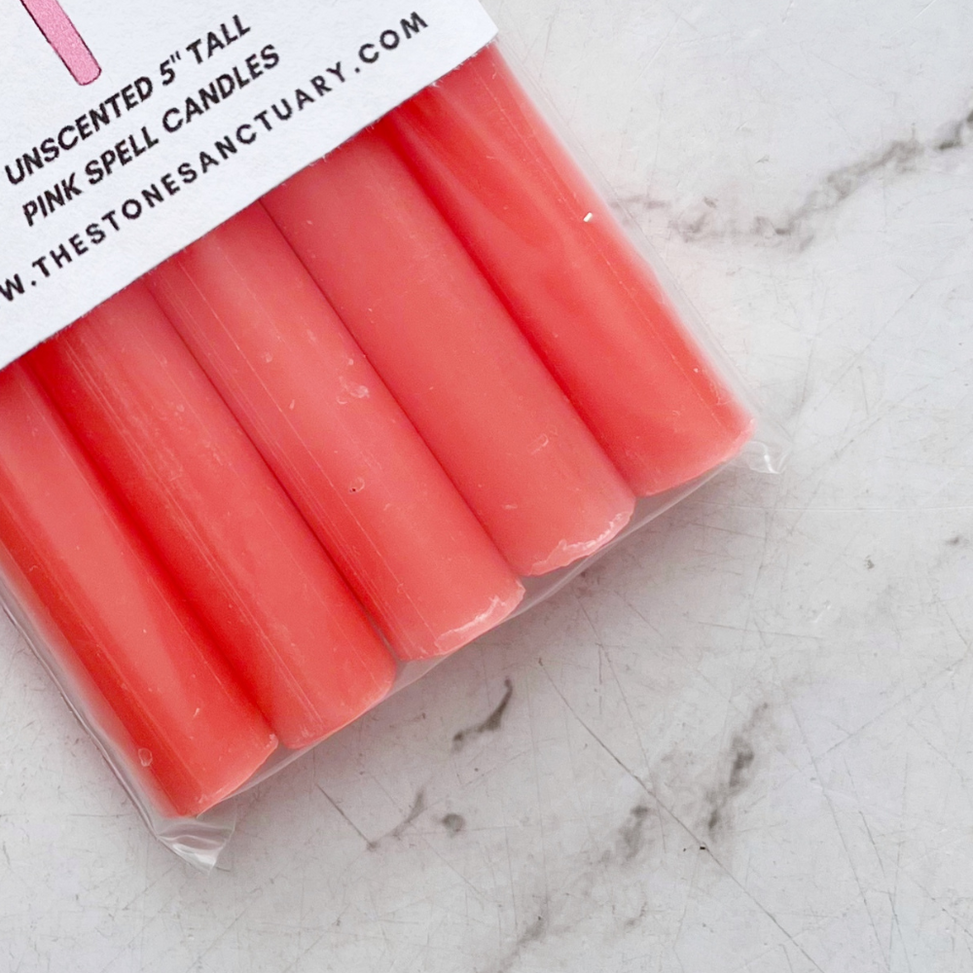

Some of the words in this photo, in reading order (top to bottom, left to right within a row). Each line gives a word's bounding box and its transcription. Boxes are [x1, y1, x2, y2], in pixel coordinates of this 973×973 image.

[4, 76, 153, 185] UNSCENTED
[185, 14, 251, 64] TALL
[22, 172, 83, 227] PINK
[84, 126, 159, 185] SPELL
[162, 44, 280, 133] CANDLES
